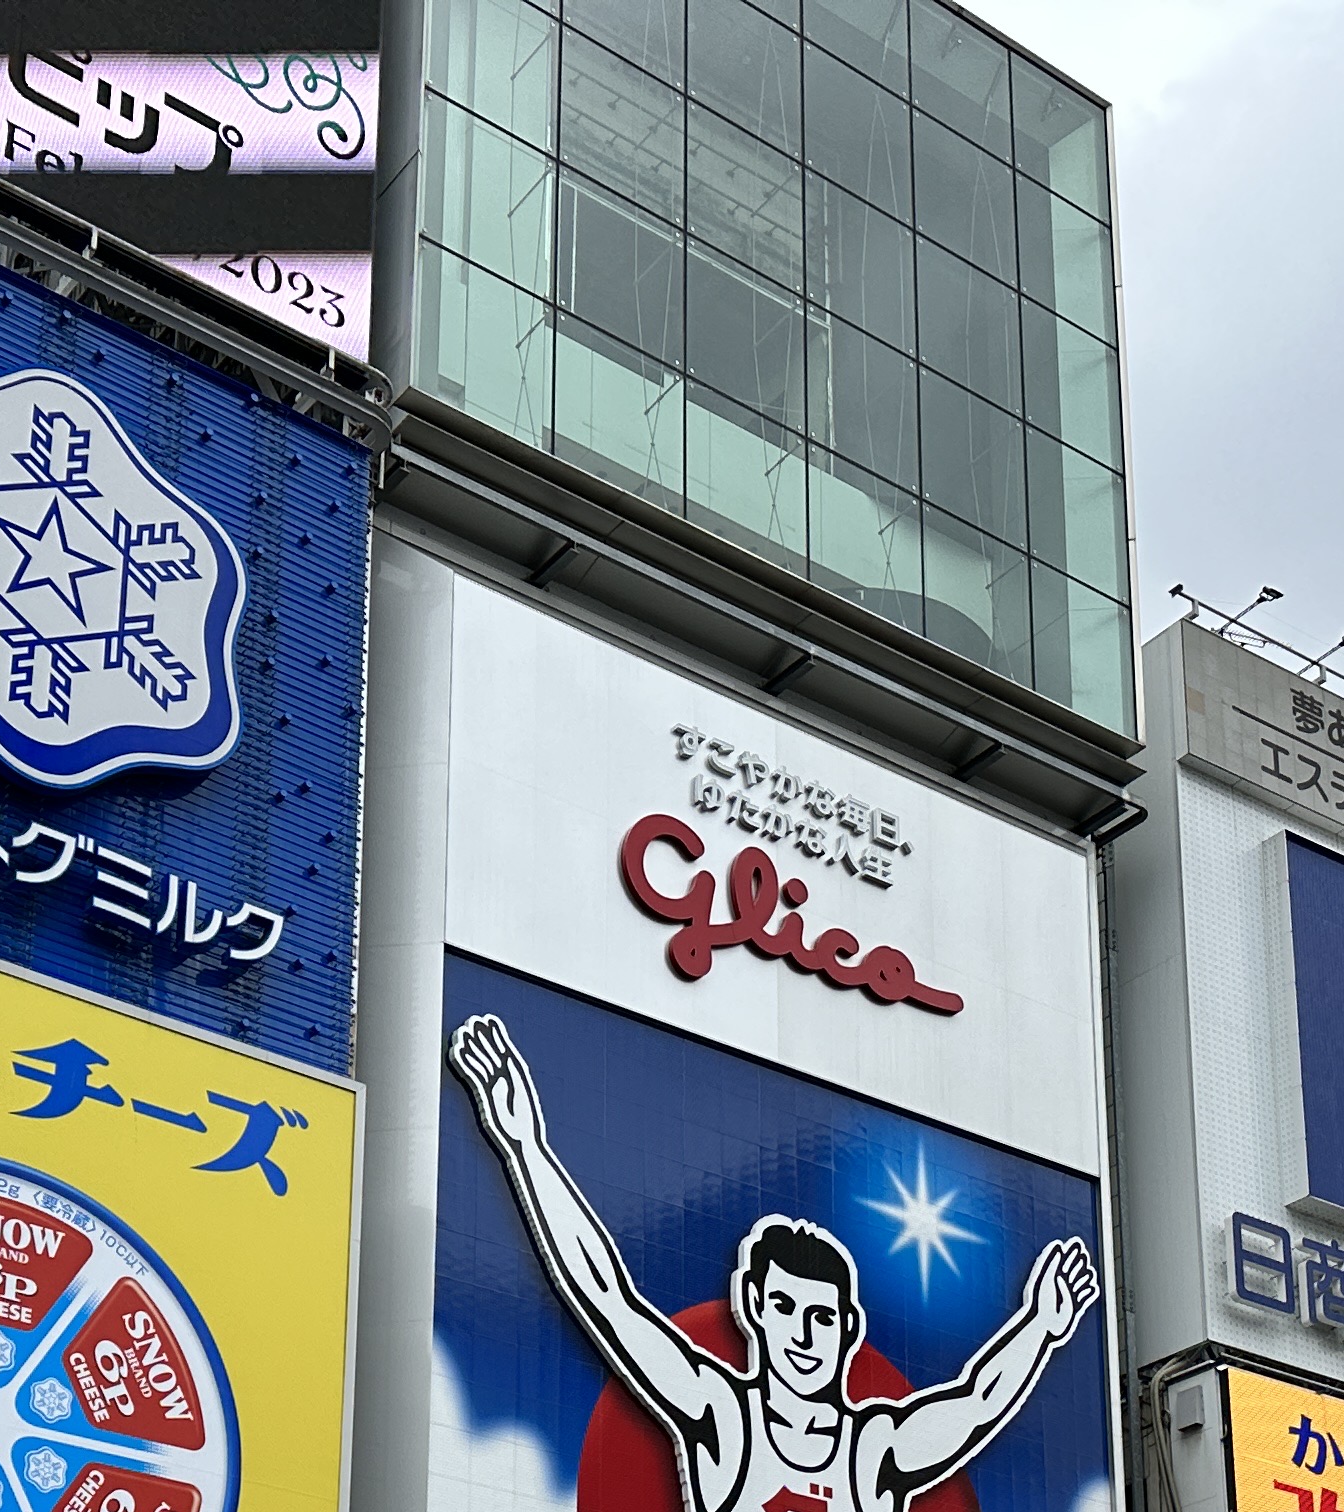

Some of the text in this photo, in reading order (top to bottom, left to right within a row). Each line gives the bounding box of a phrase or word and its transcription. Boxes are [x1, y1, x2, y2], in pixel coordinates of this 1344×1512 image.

[670, 722, 913, 856] すこやかな毎日、
[690, 773, 894, 890] ゆたかな人生
[617, 813, 965, 1016] Glico
[68, 1351, 110, 1424] CHEESE
[93, 1338, 136, 1419] 6P
[122, 1309, 194, 1423] SNOW
[124, 1347, 154, 1400] BRAND
